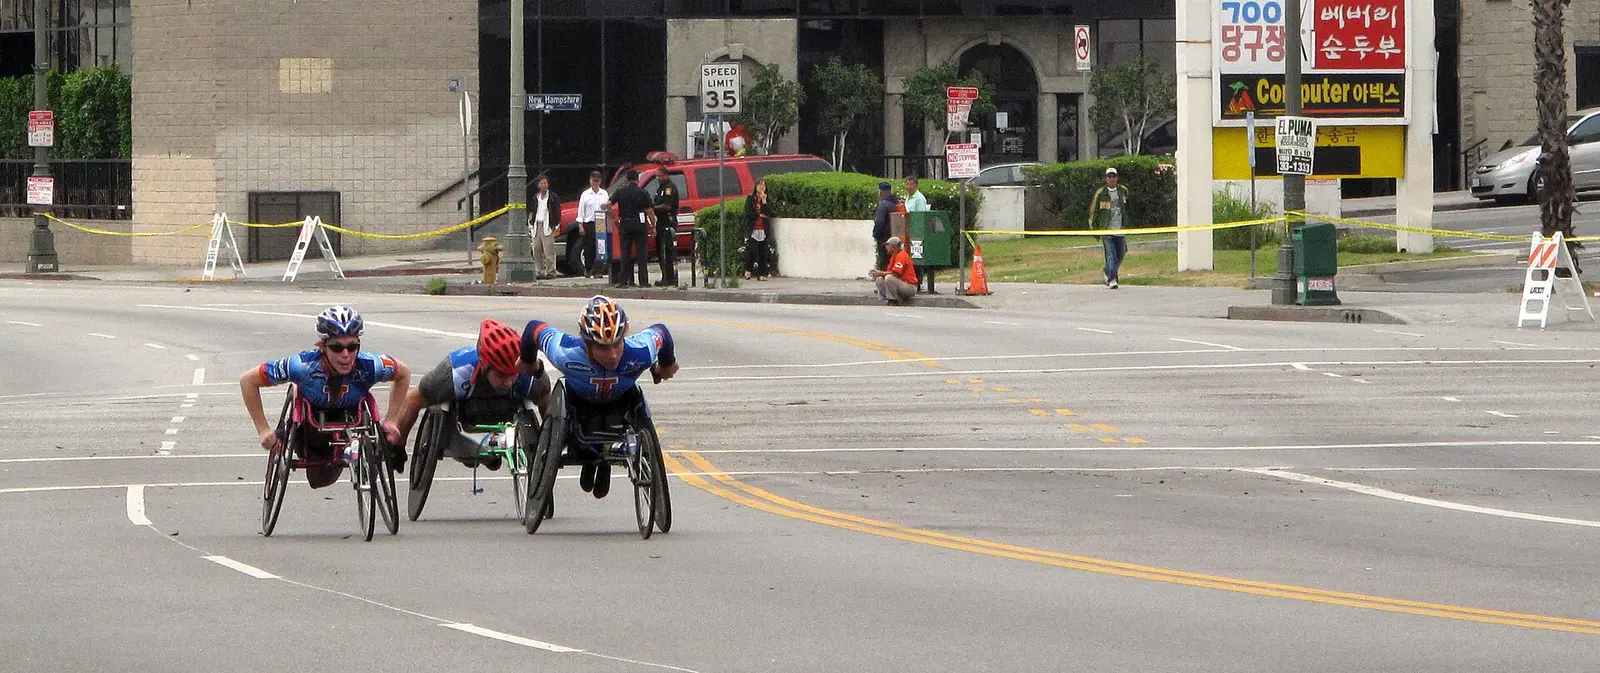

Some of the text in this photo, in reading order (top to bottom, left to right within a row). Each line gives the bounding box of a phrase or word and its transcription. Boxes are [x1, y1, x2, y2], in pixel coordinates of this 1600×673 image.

[1222, 1, 1281, 23] 700
[1320, 4, 1398, 29] 베버리
[1222, 25, 1286, 62] 당구장
[1320, 34, 1401, 60] 순두부
[704, 68, 737, 76] SPEED
[707, 79, 734, 88] LIMIT
[545, 96, 580, 105] Hampshire
[706, 90, 737, 108] 35
[1257, 78, 1350, 108] Coputer
[949, 104, 957, 113] NO
[1256, 127, 1276, 144] 한
[1278, 119, 1287, 135] EL
[1288, 119, 1312, 137] PUMA
[948, 153, 958, 162] NO
